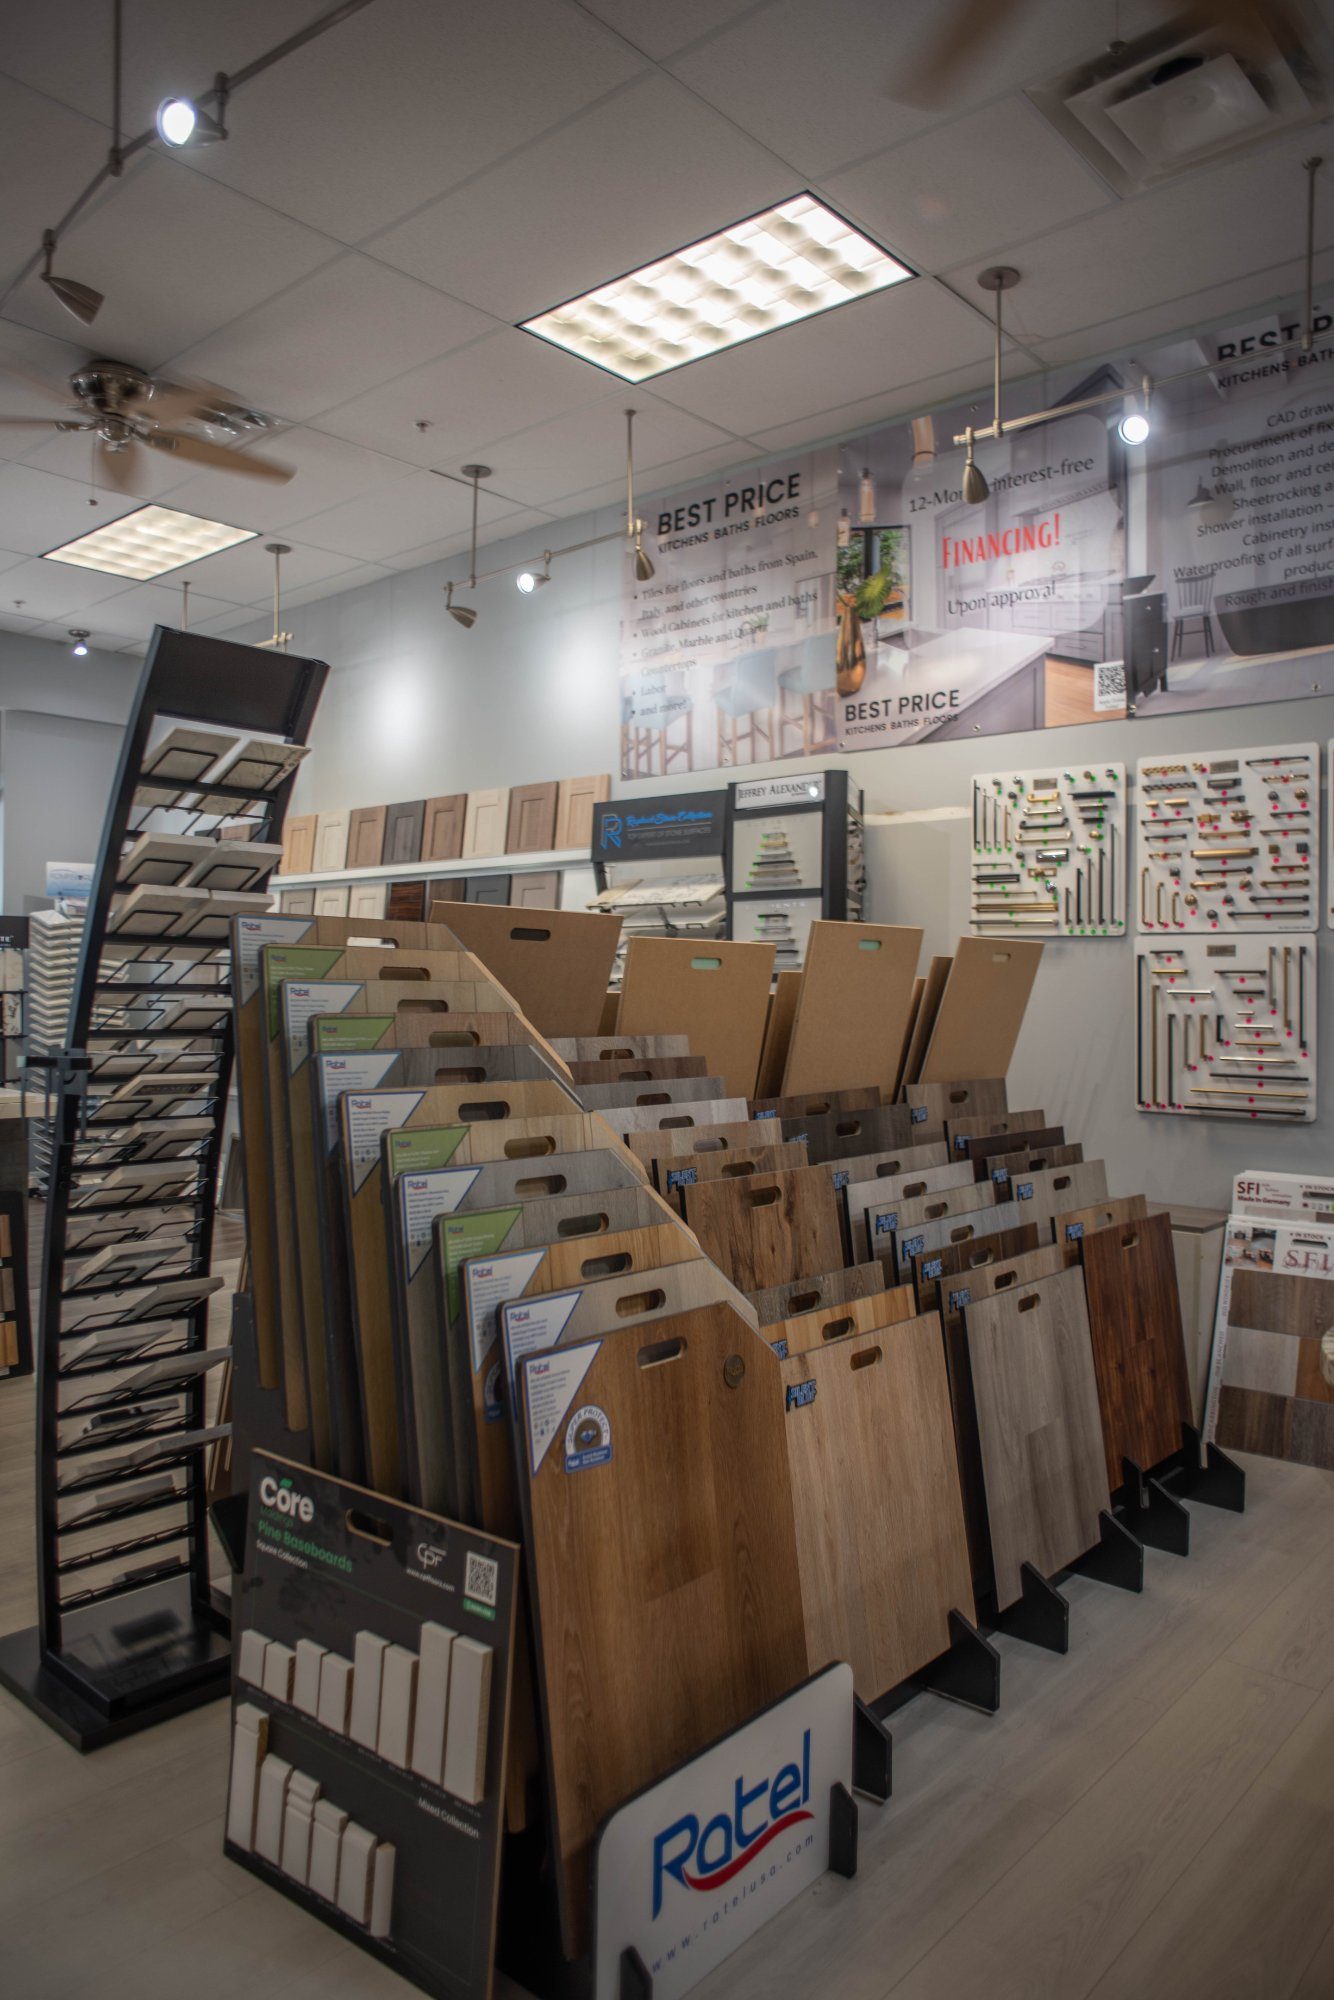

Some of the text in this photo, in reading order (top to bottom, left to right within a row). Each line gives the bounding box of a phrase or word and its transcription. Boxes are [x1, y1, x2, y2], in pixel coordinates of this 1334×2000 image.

[1217, 360, 1291, 390] KITCHENS
[1267, 410, 1296, 427] CAD
[1209, 431, 1296, 459] Procurement
[1299, 423, 1315, 440] of
[992, 457, 1096, 492] interest-free
[1211, 452, 1285, 478] Demolition
[1288, 441, 1314, 459] and
[1214, 479, 1248, 497] Wall,
[1250, 472, 1283, 488] floor
[1286, 464, 1312, 482] and
[1233, 484, 1322, 511] Sheetrocking
[657, 472, 801, 536] BEST PRICE
[1197, 502, 1324, 538] Shower installation
[658, 506, 799, 555] KITCHENS BATHS FLOORS
[942, 511, 1062, 570] FINANCING!
[1242, 525, 1309, 547] Cabinetry
[664, 584, 680, 597] for
[707, 569, 727, 583] and
[728, 563, 757, 580] baths
[758, 558, 784, 573] from
[1173, 553, 1266, 579] Waterproofing
[1268, 544, 1284, 562] of
[1286, 543, 1302, 558] all
[665, 600, 685, 614] and
[686, 595, 709, 611] other
[710, 584, 758, 604] countries
[947, 579, 1057, 617] Upon approval
[1224, 588, 1267, 608] Rough
[1269, 583, 1297, 599] and
[641, 624, 667, 639] Wood
[668, 615, 711, 634] Cabinets
[726, 602, 765, 620] kitchen
[765, 596, 786, 611] and
[787, 591, 818, 608] baths
[678, 633, 715, 650] Marble
[715, 630, 734, 644] and
[639, 704, 659, 717] and
[844, 688, 961, 723] BEST PRICE
[844, 711, 960, 737] KITCHENS BATHS FLOORS
[738, 786, 767, 801] JEFFREY
[1237, 1181, 1261, 1195] SFI
[1262, 1197, 1291, 1207] Germany
[259, 1475, 315, 1523] Core
[258, 1519, 353, 1573] Pine Baseboards
[277, 1548, 309, 1570] Collection
[417, 1796, 480, 1839] Mixed Collection
[651, 1726, 812, 1923] Ratel
